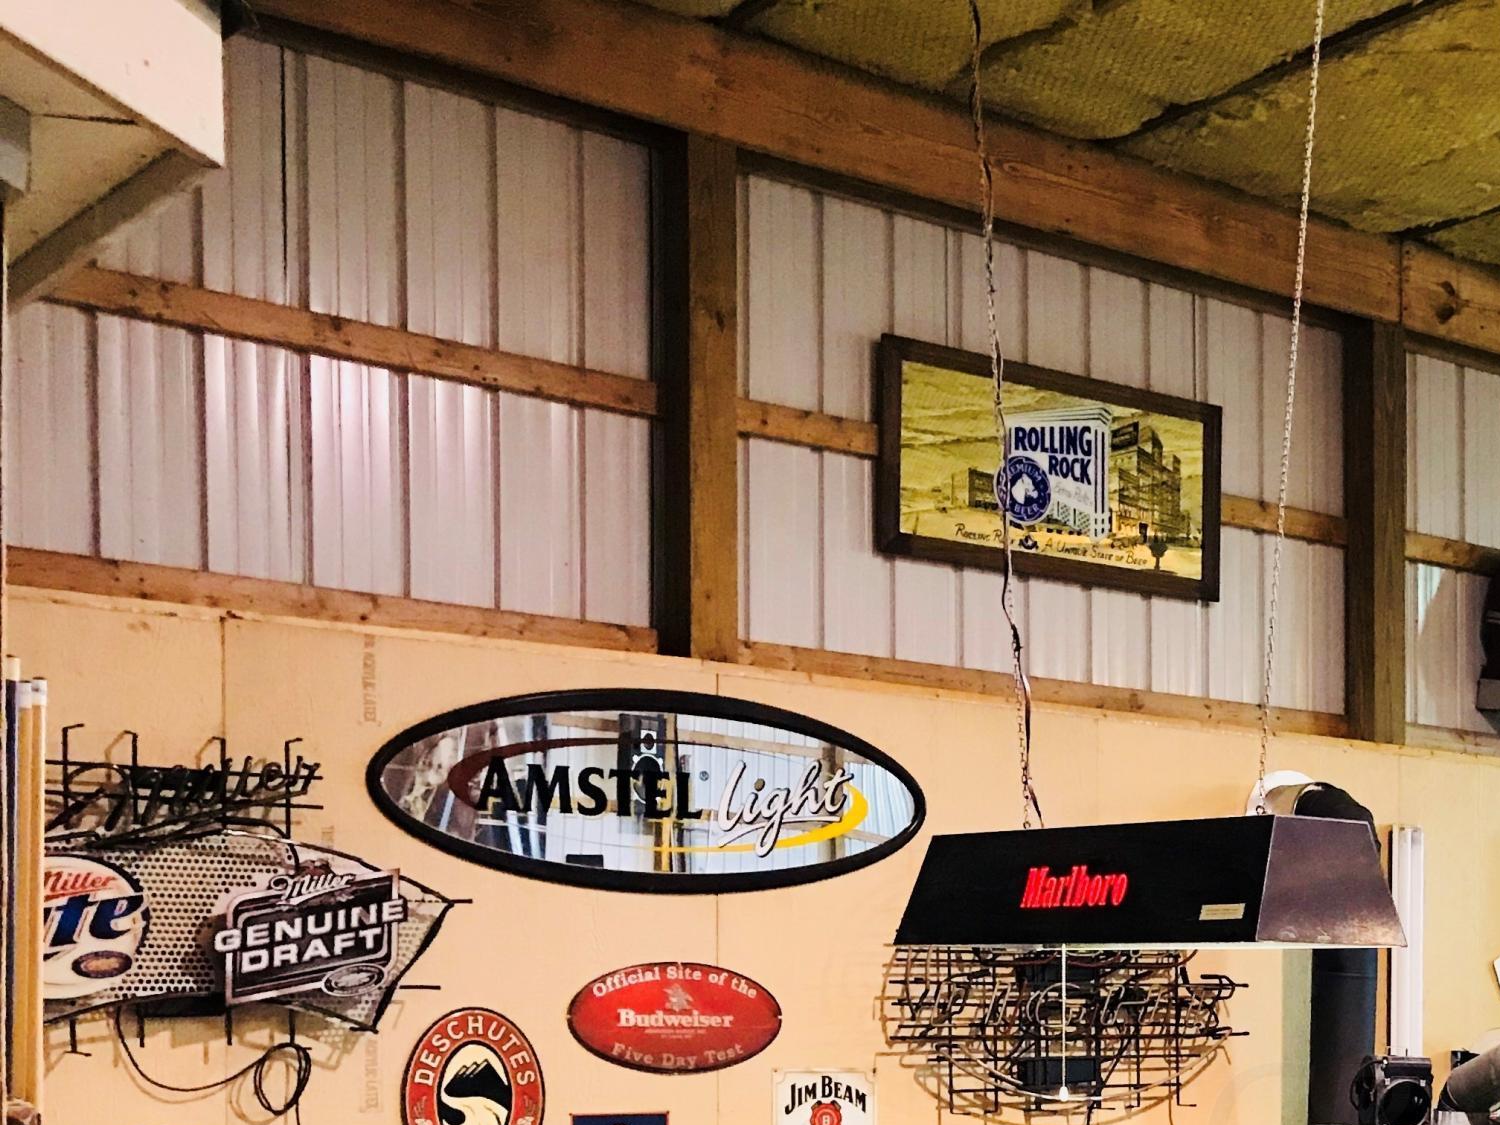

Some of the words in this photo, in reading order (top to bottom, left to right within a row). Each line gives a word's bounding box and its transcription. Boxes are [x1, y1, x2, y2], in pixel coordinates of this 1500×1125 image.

[1014, 426, 1092, 457] ROLLING
[1048, 455, 1092, 485] ROCK
[270, 873, 356, 902] Miller
[1020, 864, 1129, 909] Marlboro
[214, 899, 404, 952] GENUINE
[241, 927, 382, 974] DRAFT
[592, 966, 661, 998] Official
[666, 966, 702, 980] Site
[708, 972, 728, 986] of
[731, 977, 757, 999] the
[617, 1008, 734, 1028] Budweiser
[414, 1015, 535, 1086] DESCHUTES
[611, 1042, 654, 1065] Five
[662, 1053, 697, 1069] Day
[704, 1043, 744, 1064] Test
[784, 1082, 817, 1115] JIM
[821, 1075, 867, 1114] BEAM
